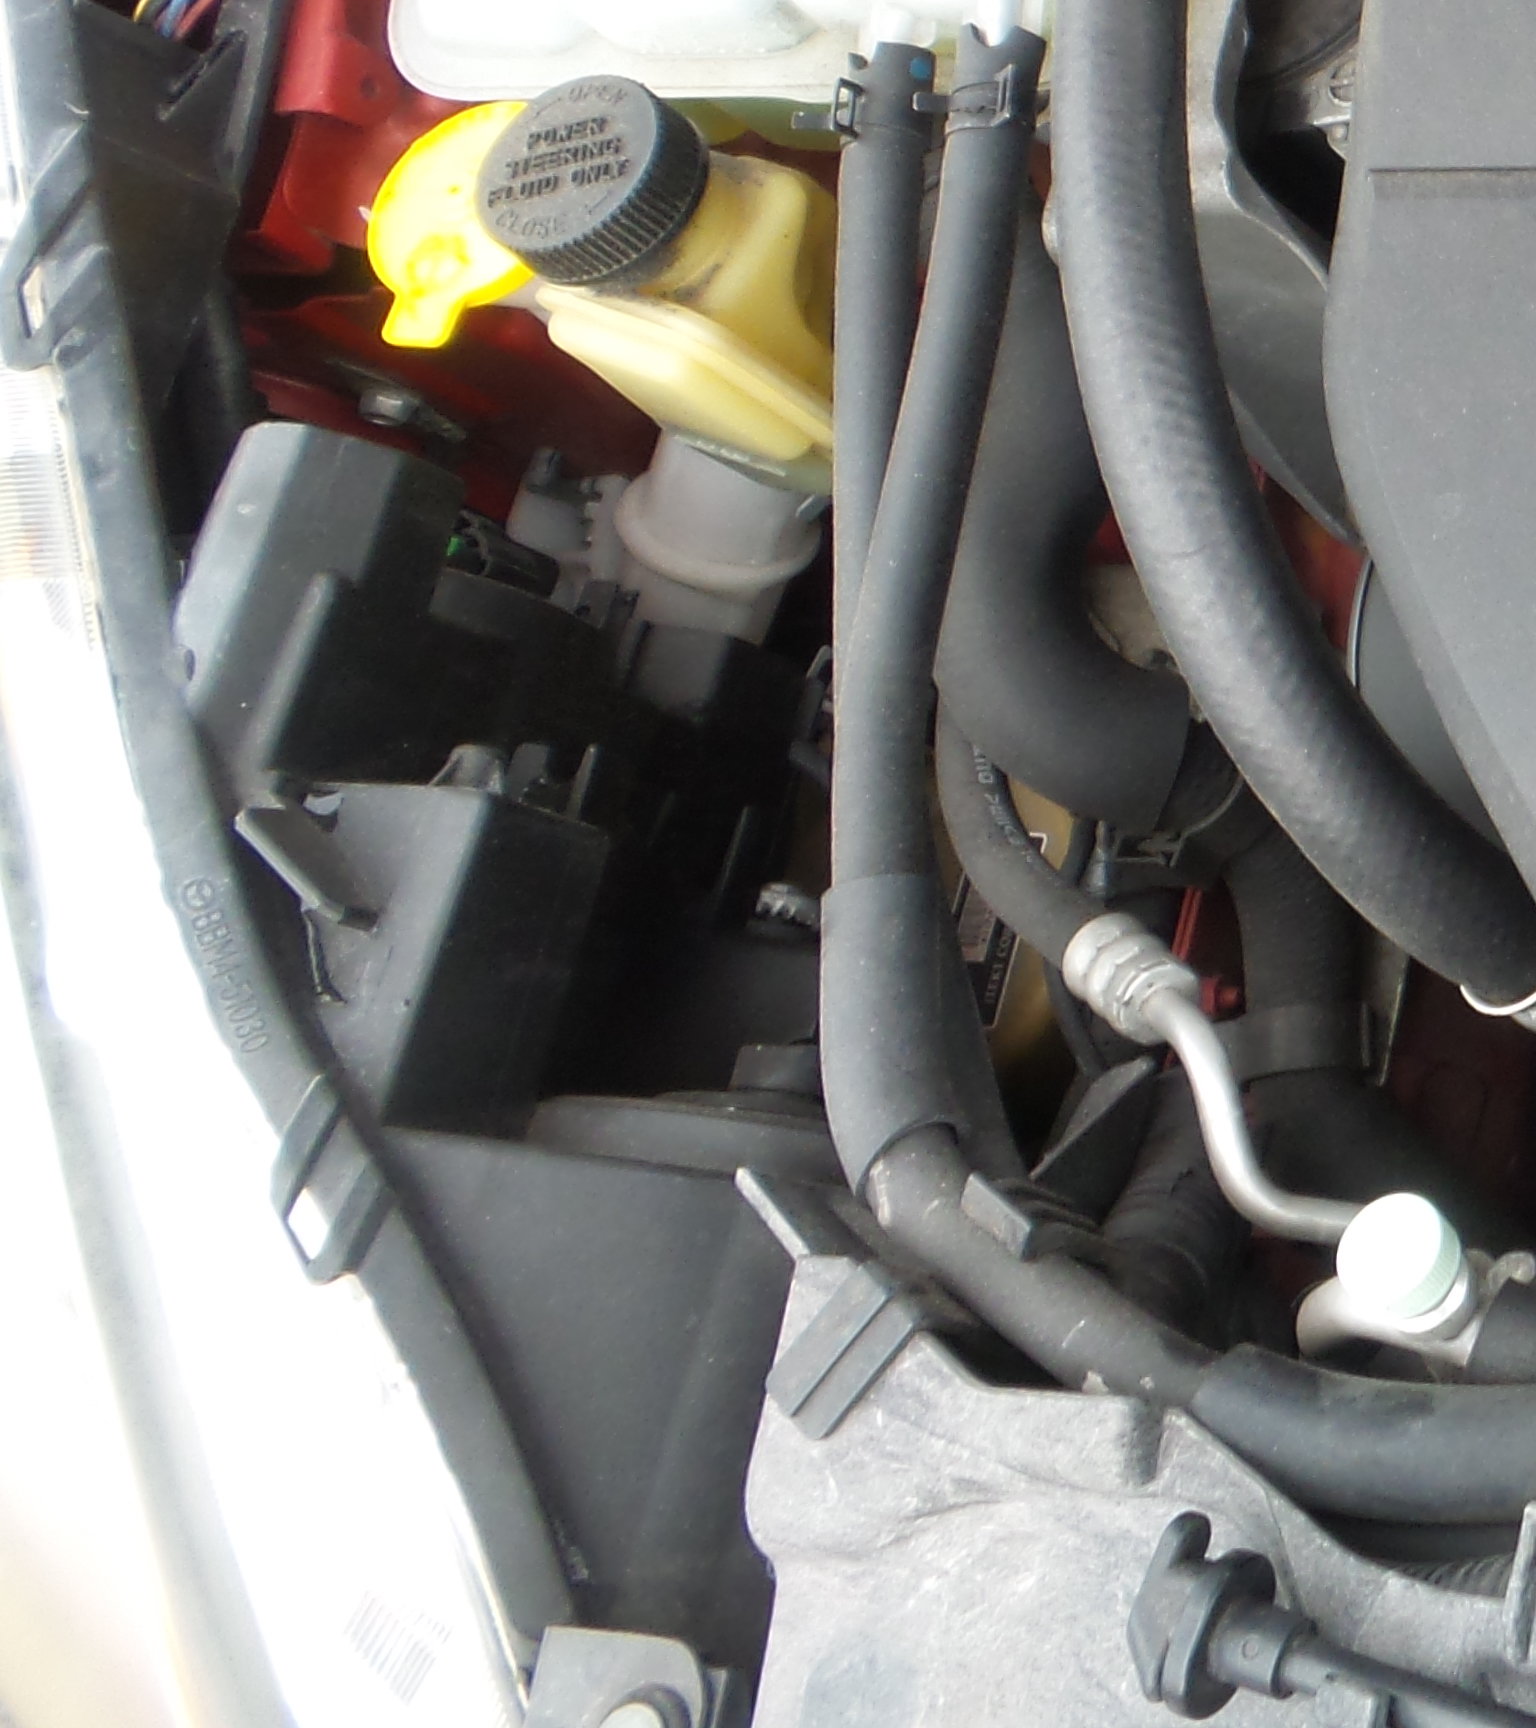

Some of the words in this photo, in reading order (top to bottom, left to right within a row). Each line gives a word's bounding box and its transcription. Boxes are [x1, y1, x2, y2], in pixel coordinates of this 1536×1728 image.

[526, 115, 611, 151] POWER
[504, 136, 623, 180] STEERING
[486, 173, 561, 209] FLUID
[570, 157, 631, 188] ONLY
